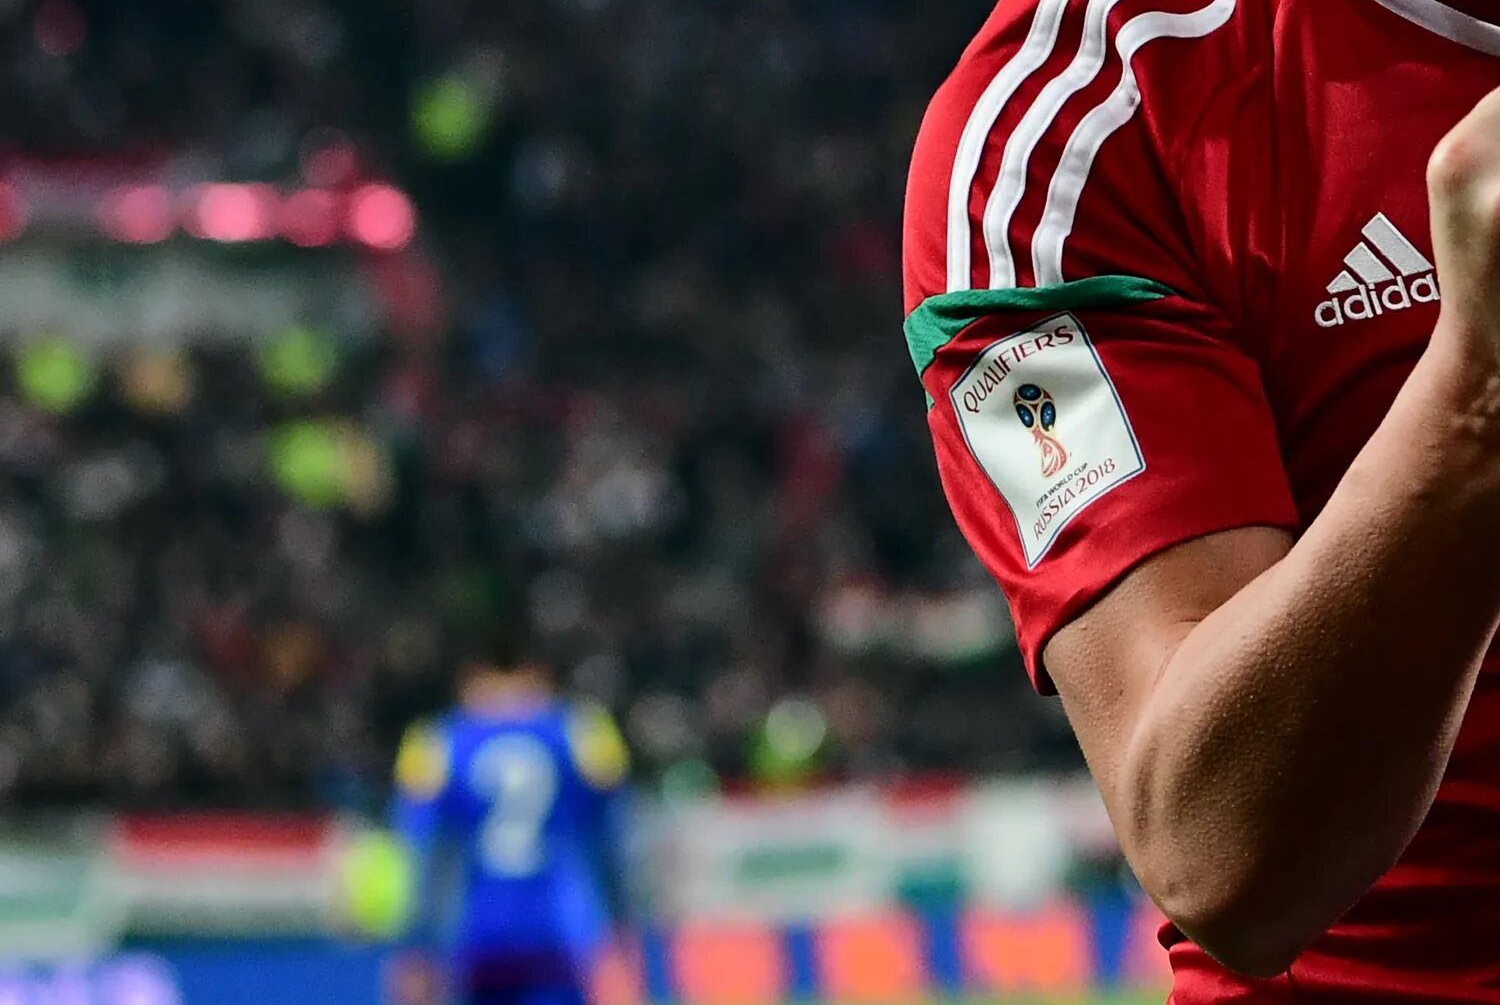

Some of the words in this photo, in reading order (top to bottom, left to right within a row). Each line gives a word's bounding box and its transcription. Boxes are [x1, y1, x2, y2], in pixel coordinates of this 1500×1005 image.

[1314, 273, 1441, 328] adida
[963, 325, 1074, 413] QUALIFIERS
[1033, 487, 1076, 540] RUSSIA
[1076, 458, 1115, 494] 2018
[1047, 473, 1073, 496] WORLD
[1073, 462, 1088, 476] CUP
